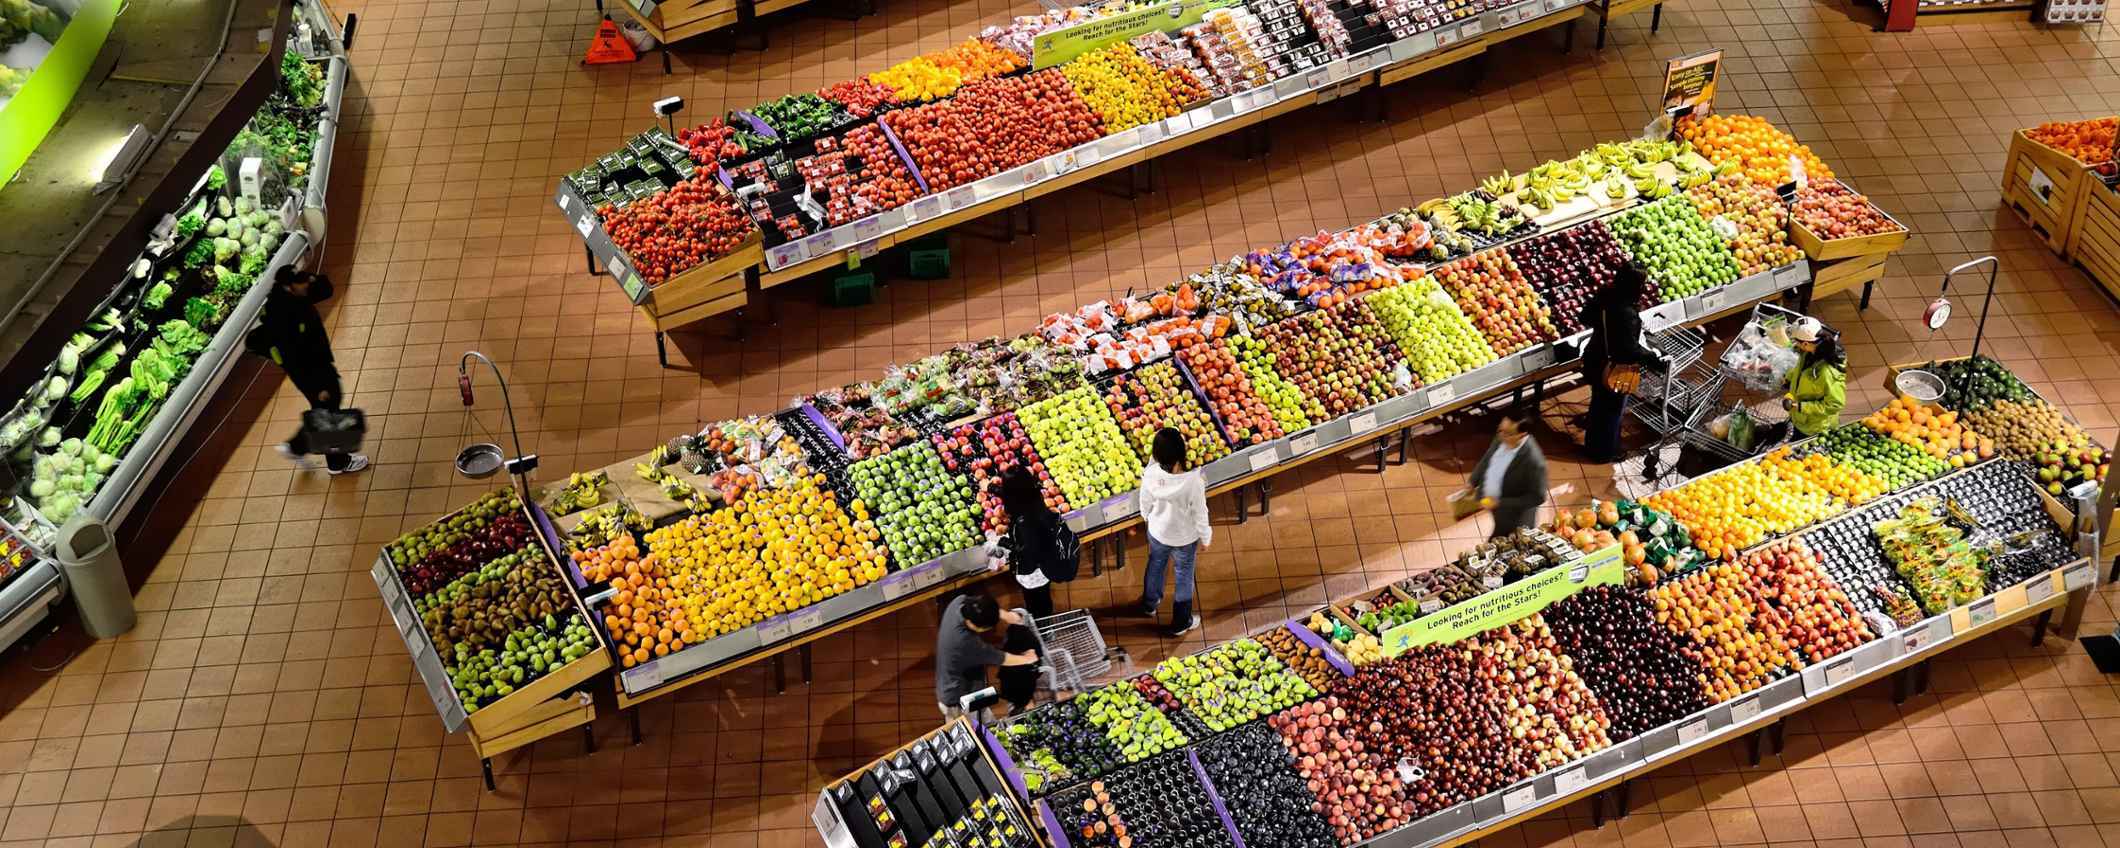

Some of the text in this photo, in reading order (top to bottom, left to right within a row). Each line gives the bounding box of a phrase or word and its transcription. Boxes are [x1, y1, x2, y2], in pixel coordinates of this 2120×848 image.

[1066, 27, 1092, 39] Looking
[1093, 24, 1102, 34] for
[1103, 16, 1137, 30] nutritious
[1137, 8, 1165, 21] choices?
[1083, 19, 1148, 41] Reach for the Stars!
[1427, 612, 1463, 630] Looking
[1465, 604, 1477, 616] for
[1480, 588, 1524, 610] nutritious
[1526, 571, 1564, 592] choices?
[1452, 614, 1480, 630] Reach
[1482, 608, 1495, 621] for
[1497, 602, 1512, 614] the
[1515, 589, 1542, 607] Stars!
